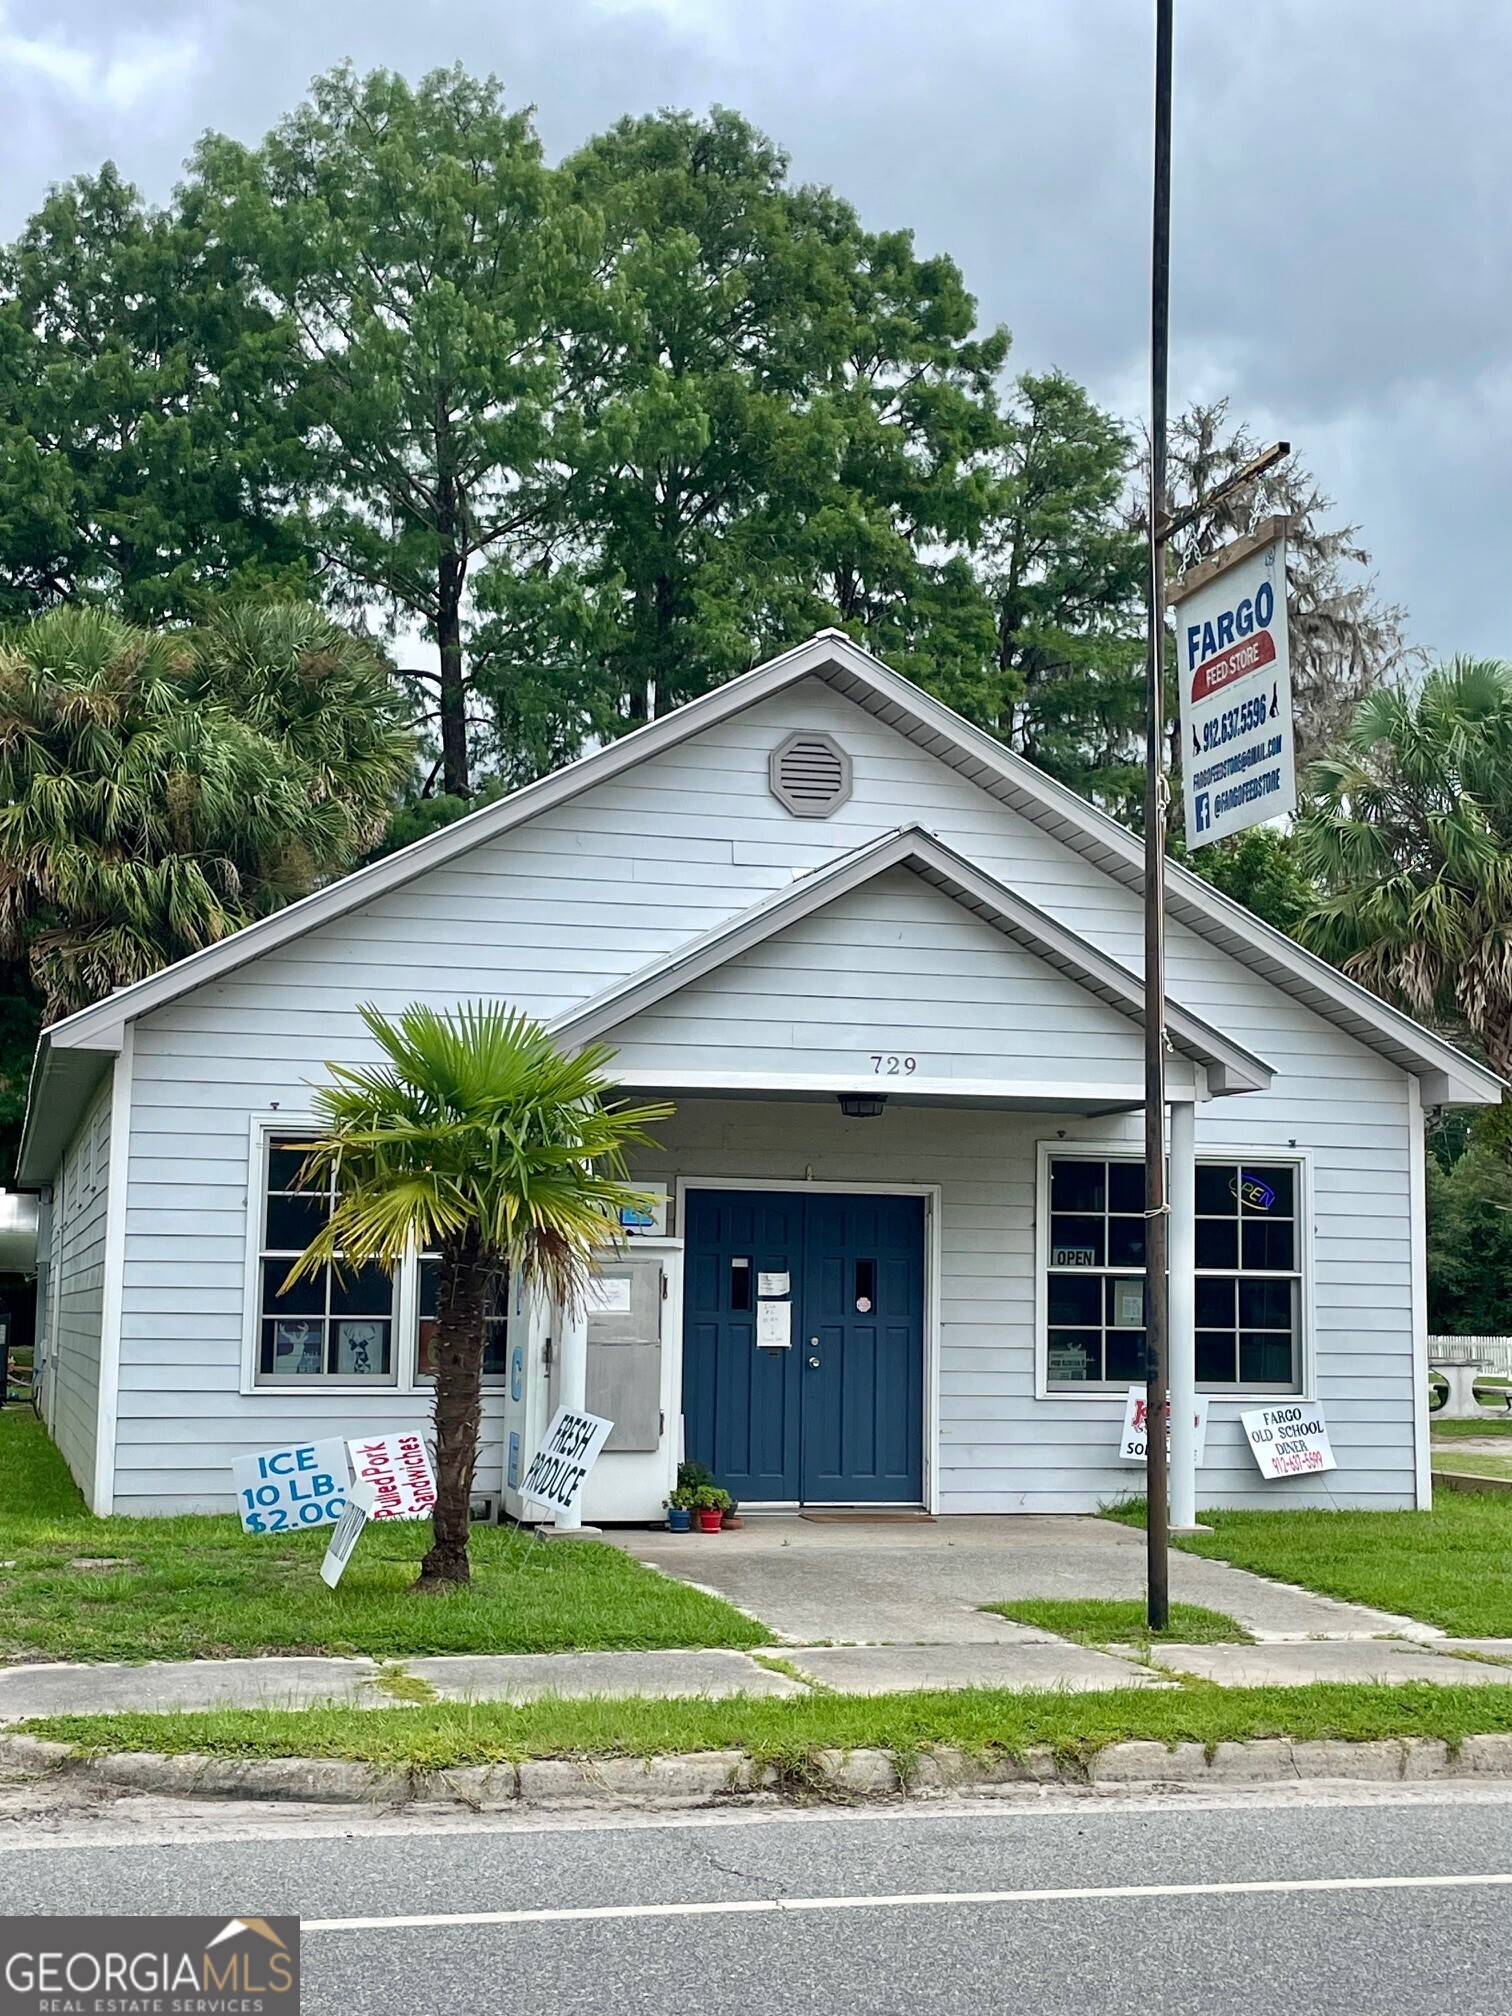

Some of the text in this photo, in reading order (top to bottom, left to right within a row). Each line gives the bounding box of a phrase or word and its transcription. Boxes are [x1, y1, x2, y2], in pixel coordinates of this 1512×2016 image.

[1188, 581, 1274, 671] FARGO
[1206, 642, 1261, 688] FEED STORE
[1203, 693, 1267, 752] 912.637.5596
[1214, 767, 1281, 818] @FARGOFEEDSTORE
[870, 1056, 917, 1076] 729
[1057, 1250, 1093, 1266] OPEN
[1251, 1420, 1324, 1443] OLD SCHOOL
[1263, 1407, 1302, 1425] FARGO
[548, 1414, 598, 1461] FRESH
[1275, 1439, 1309, 1455] DINER
[258, 1447, 318, 1478] ICE
[356, 1441, 405, 1518] Pulled Pork
[394, 1436, 436, 1514] Sandwiches
[521, 1451, 587, 1508] PRODUCE
[1271, 1450, 1324, 1474] 912-637-5599
[242, 1474, 345, 1510] 10 LB.
[245, 1498, 347, 1535] $2.00
